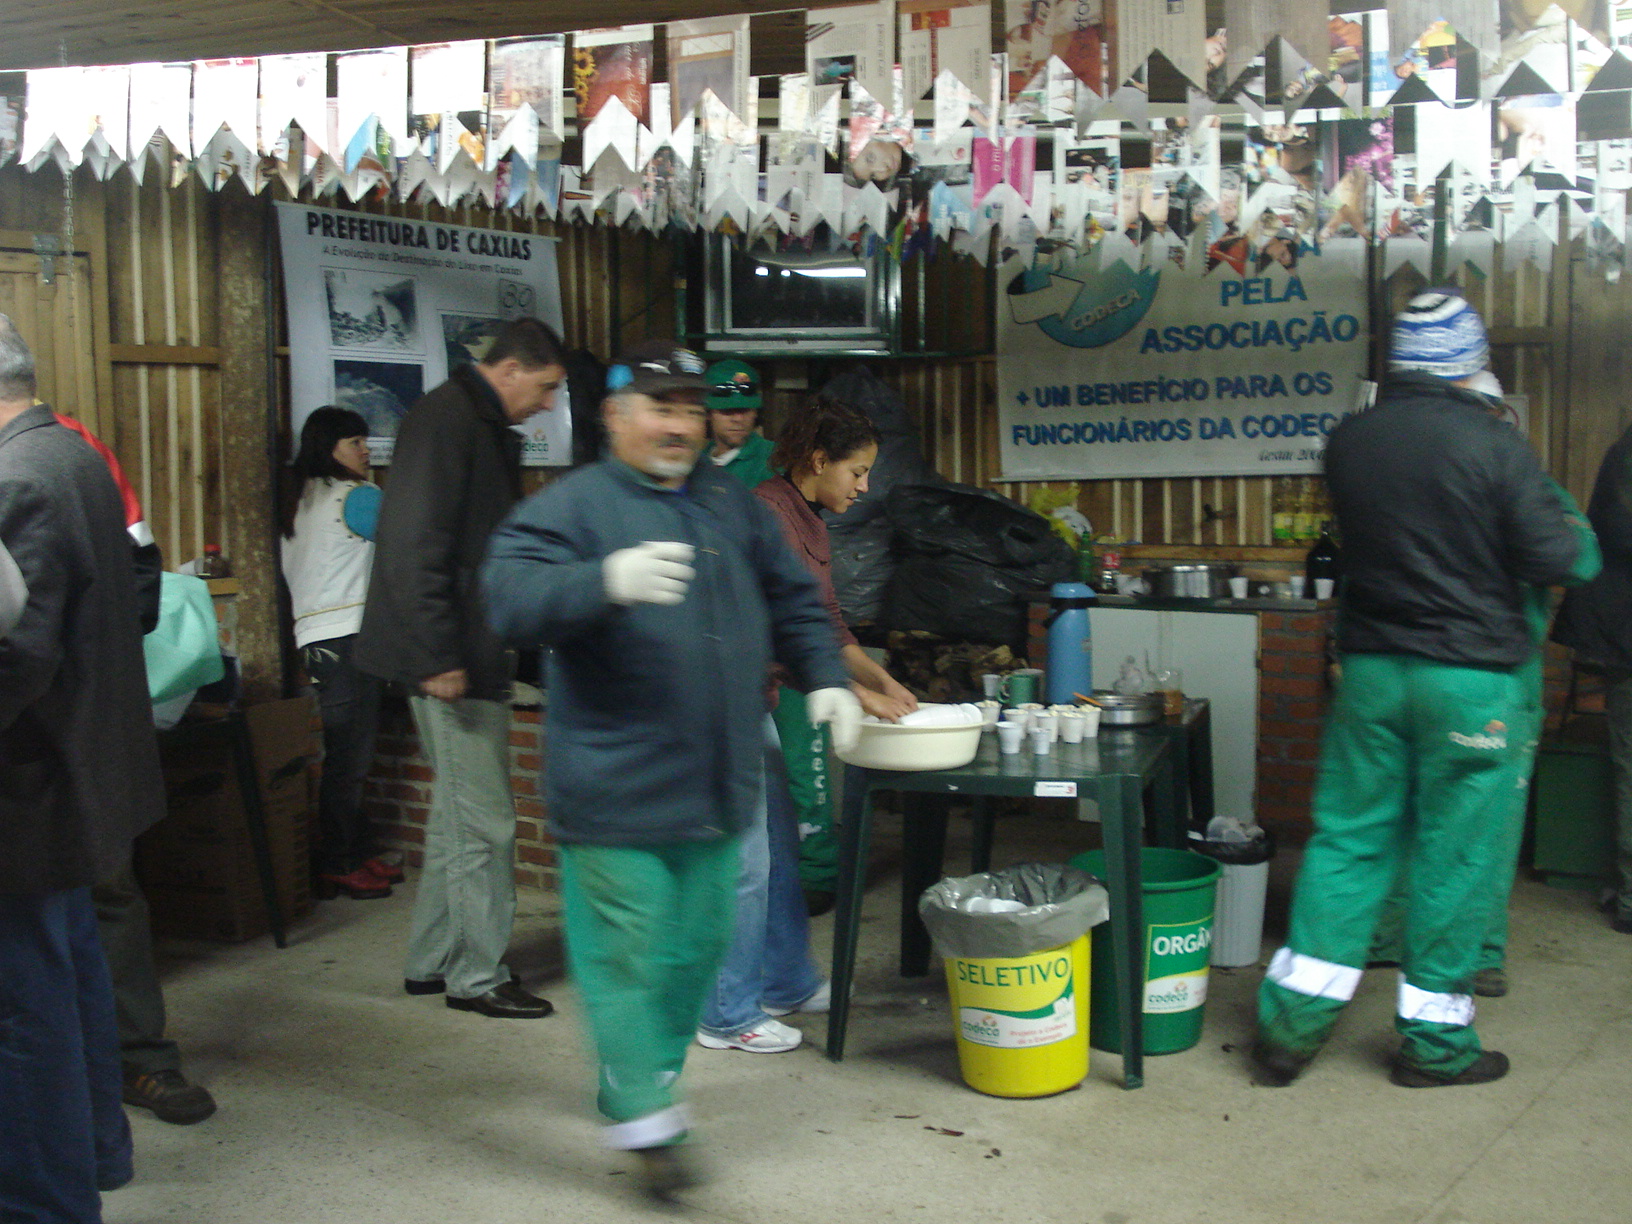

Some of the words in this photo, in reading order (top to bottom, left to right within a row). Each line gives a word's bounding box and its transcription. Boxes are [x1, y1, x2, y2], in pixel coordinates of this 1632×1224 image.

[306, 211, 431, 249] PREFEITURA
[436, 227, 460, 253] DE
[467, 232, 532, 261] CAXIAS
[1071, 289, 1143, 331] CODECA
[1220, 276, 1308, 307] PELA
[1139, 311, 1360, 354] ASSOCIAÇÃO
[1034, 385, 1071, 408] UM
[1076, 375, 1210, 407] BENEFÍCIO
[1216, 374, 1289, 400] PARA
[1293, 371, 1333, 397] OS
[1012, 416, 1192, 447] FUNCIONÁRIOS
[1200, 416, 1235, 440] DA
[1242, 411, 1362, 439] CODEC
[956, 957, 1070, 987] SELETIVO
